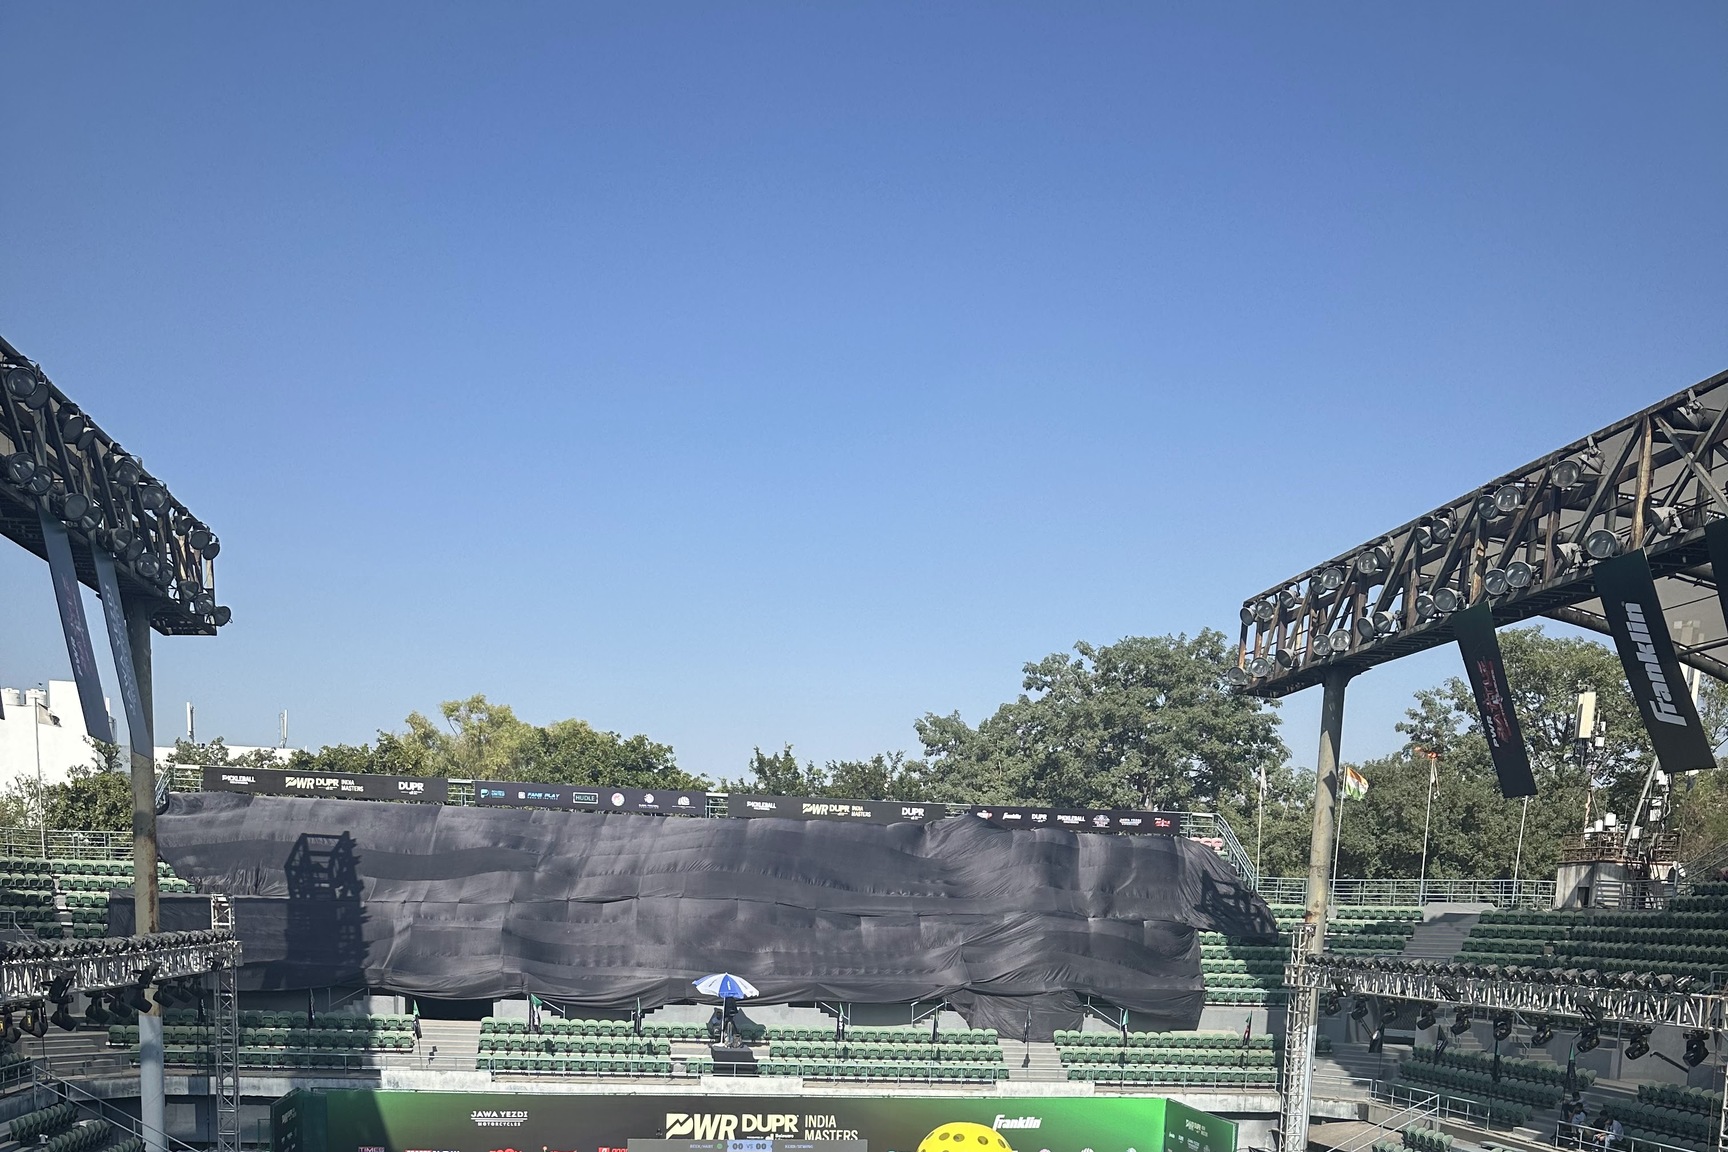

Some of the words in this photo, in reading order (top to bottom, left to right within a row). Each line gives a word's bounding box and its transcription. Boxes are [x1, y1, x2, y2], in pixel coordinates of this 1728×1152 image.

[316, 778, 339, 787] DUPR
[398, 781, 424, 791] DUPR
[829, 803, 850, 813] DUPR
[901, 807, 925, 817] DUPR
[742, 1114, 800, 1133] DUPR
[805, 1115, 837, 1128] INDIA
[805, 1129, 859, 1140] MASTERS
